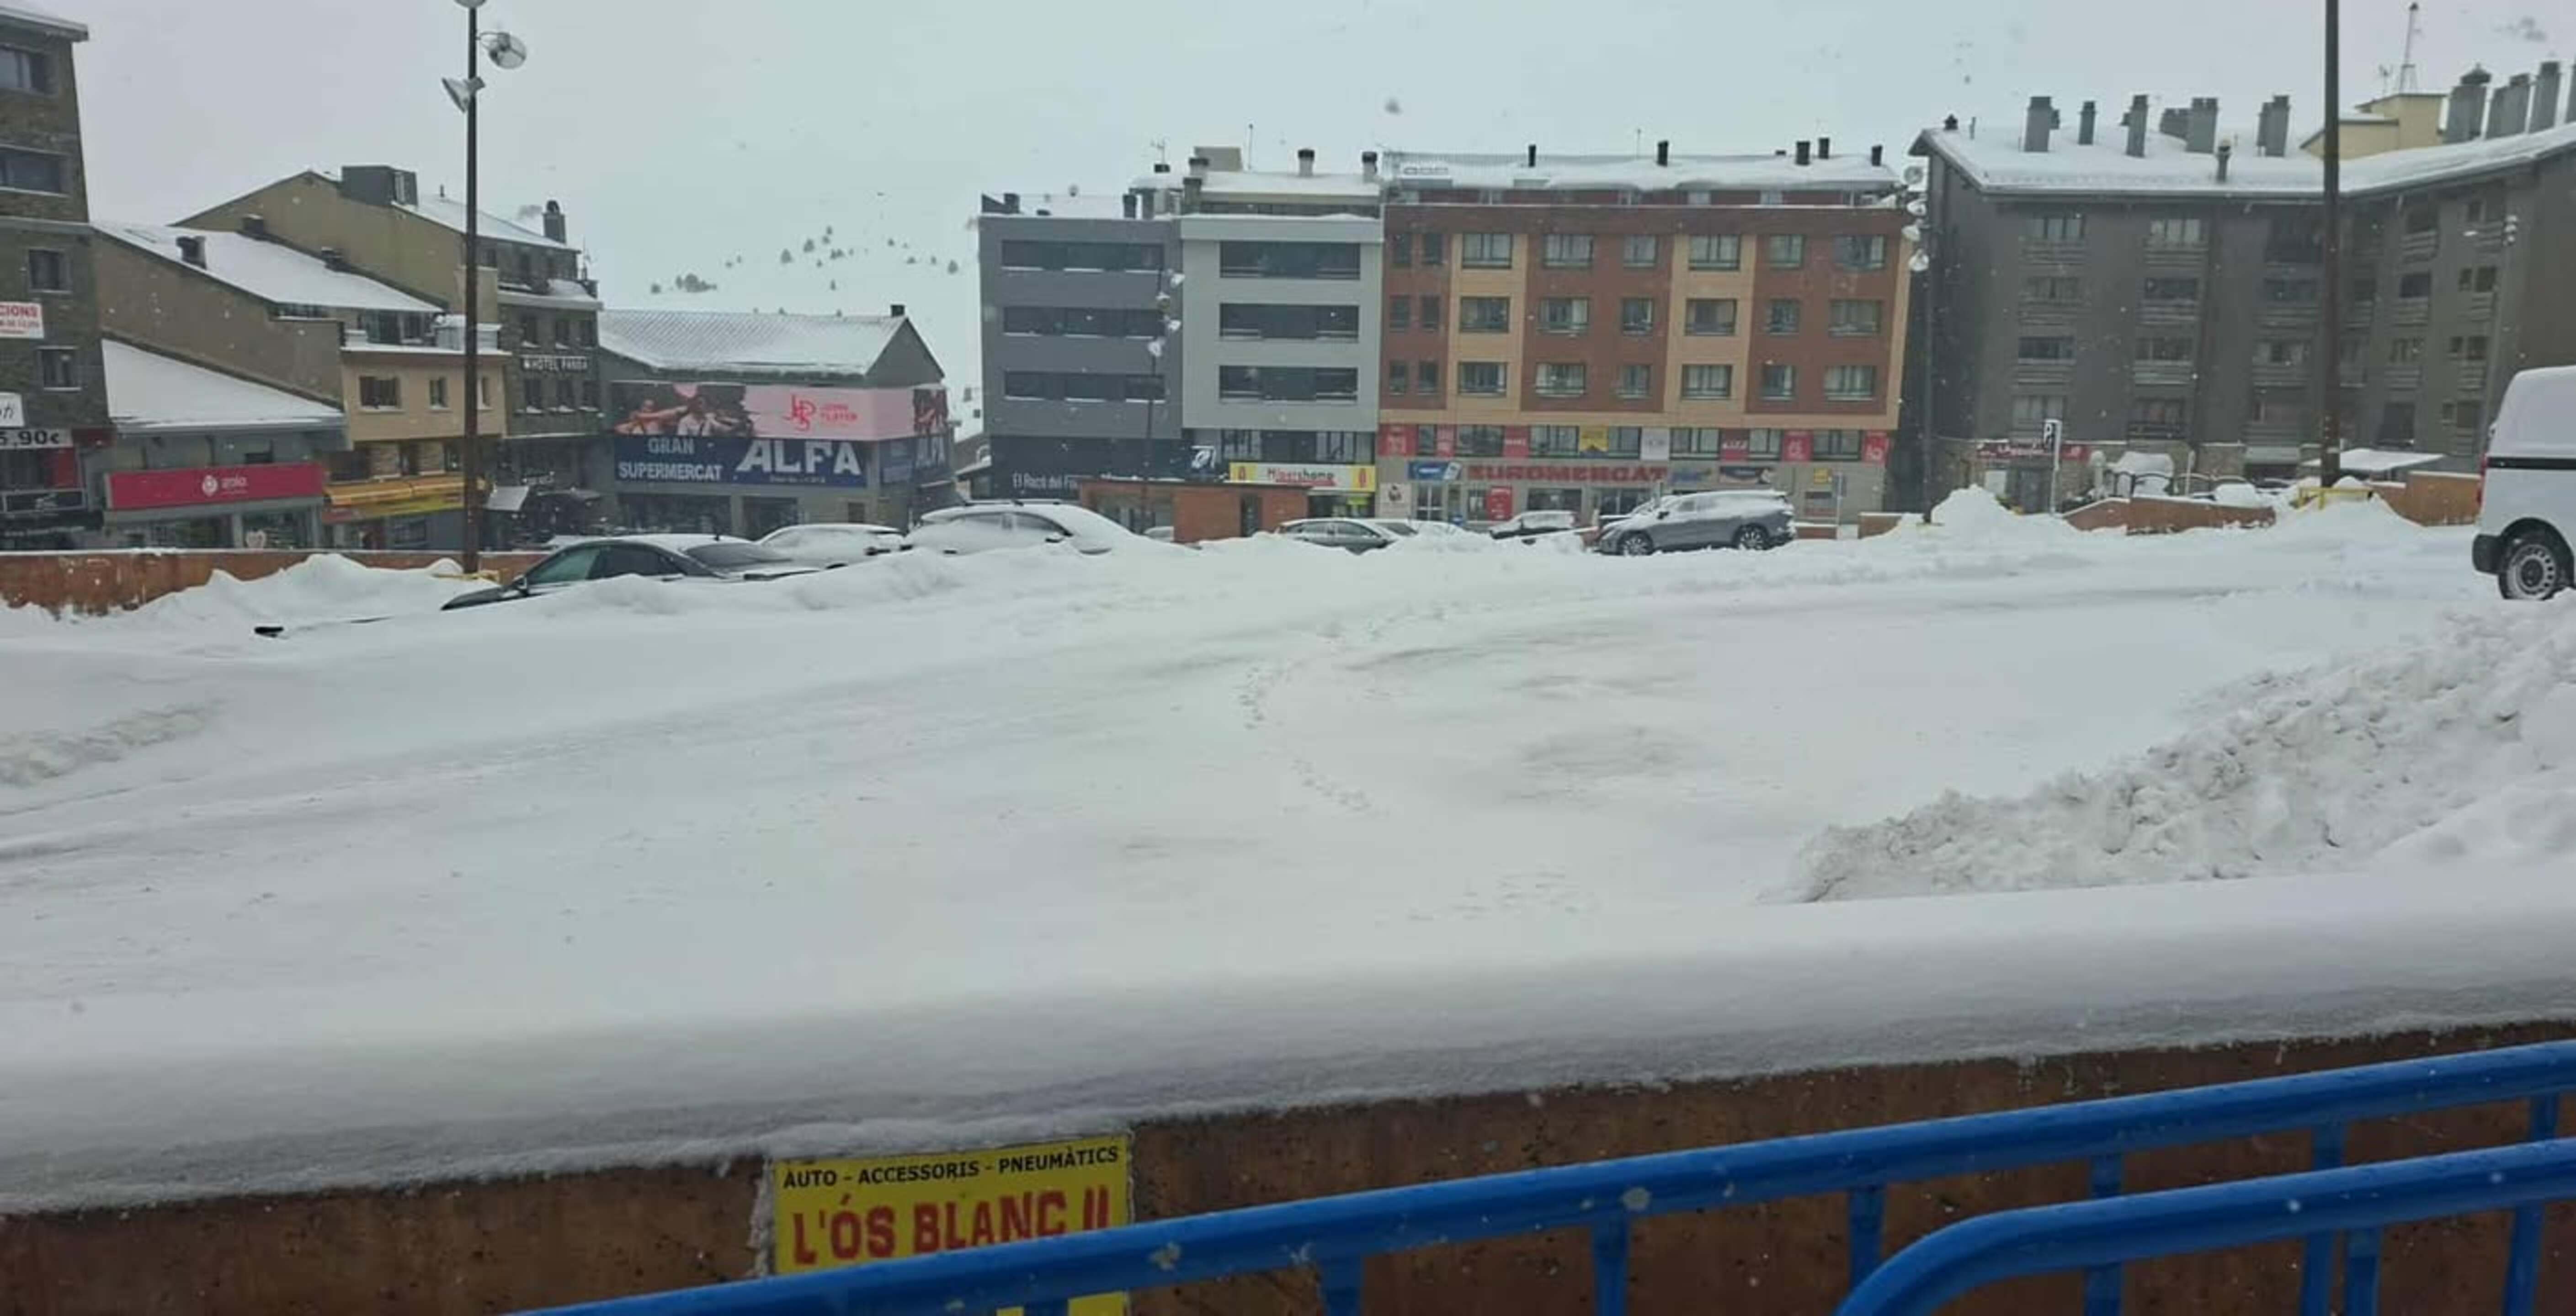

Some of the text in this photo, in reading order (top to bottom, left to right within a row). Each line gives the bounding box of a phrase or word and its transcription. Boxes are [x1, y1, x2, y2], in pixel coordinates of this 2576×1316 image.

[648, 437, 694, 454] GRAN
[735, 438, 861, 475] ALFA
[618, 461, 724, 480] SUPERMERCAT
[1468, 465, 1667, 482] EUROMERCAT
[784, 1169, 837, 1188] AUTO
[858, 1160, 979, 1184] ACCESSORIS
[999, 1144, 1118, 1173] PNEUMÀTICS
[793, 1193, 896, 1265] L'ÓS
[913, 1189, 1067, 1253] BLANC
